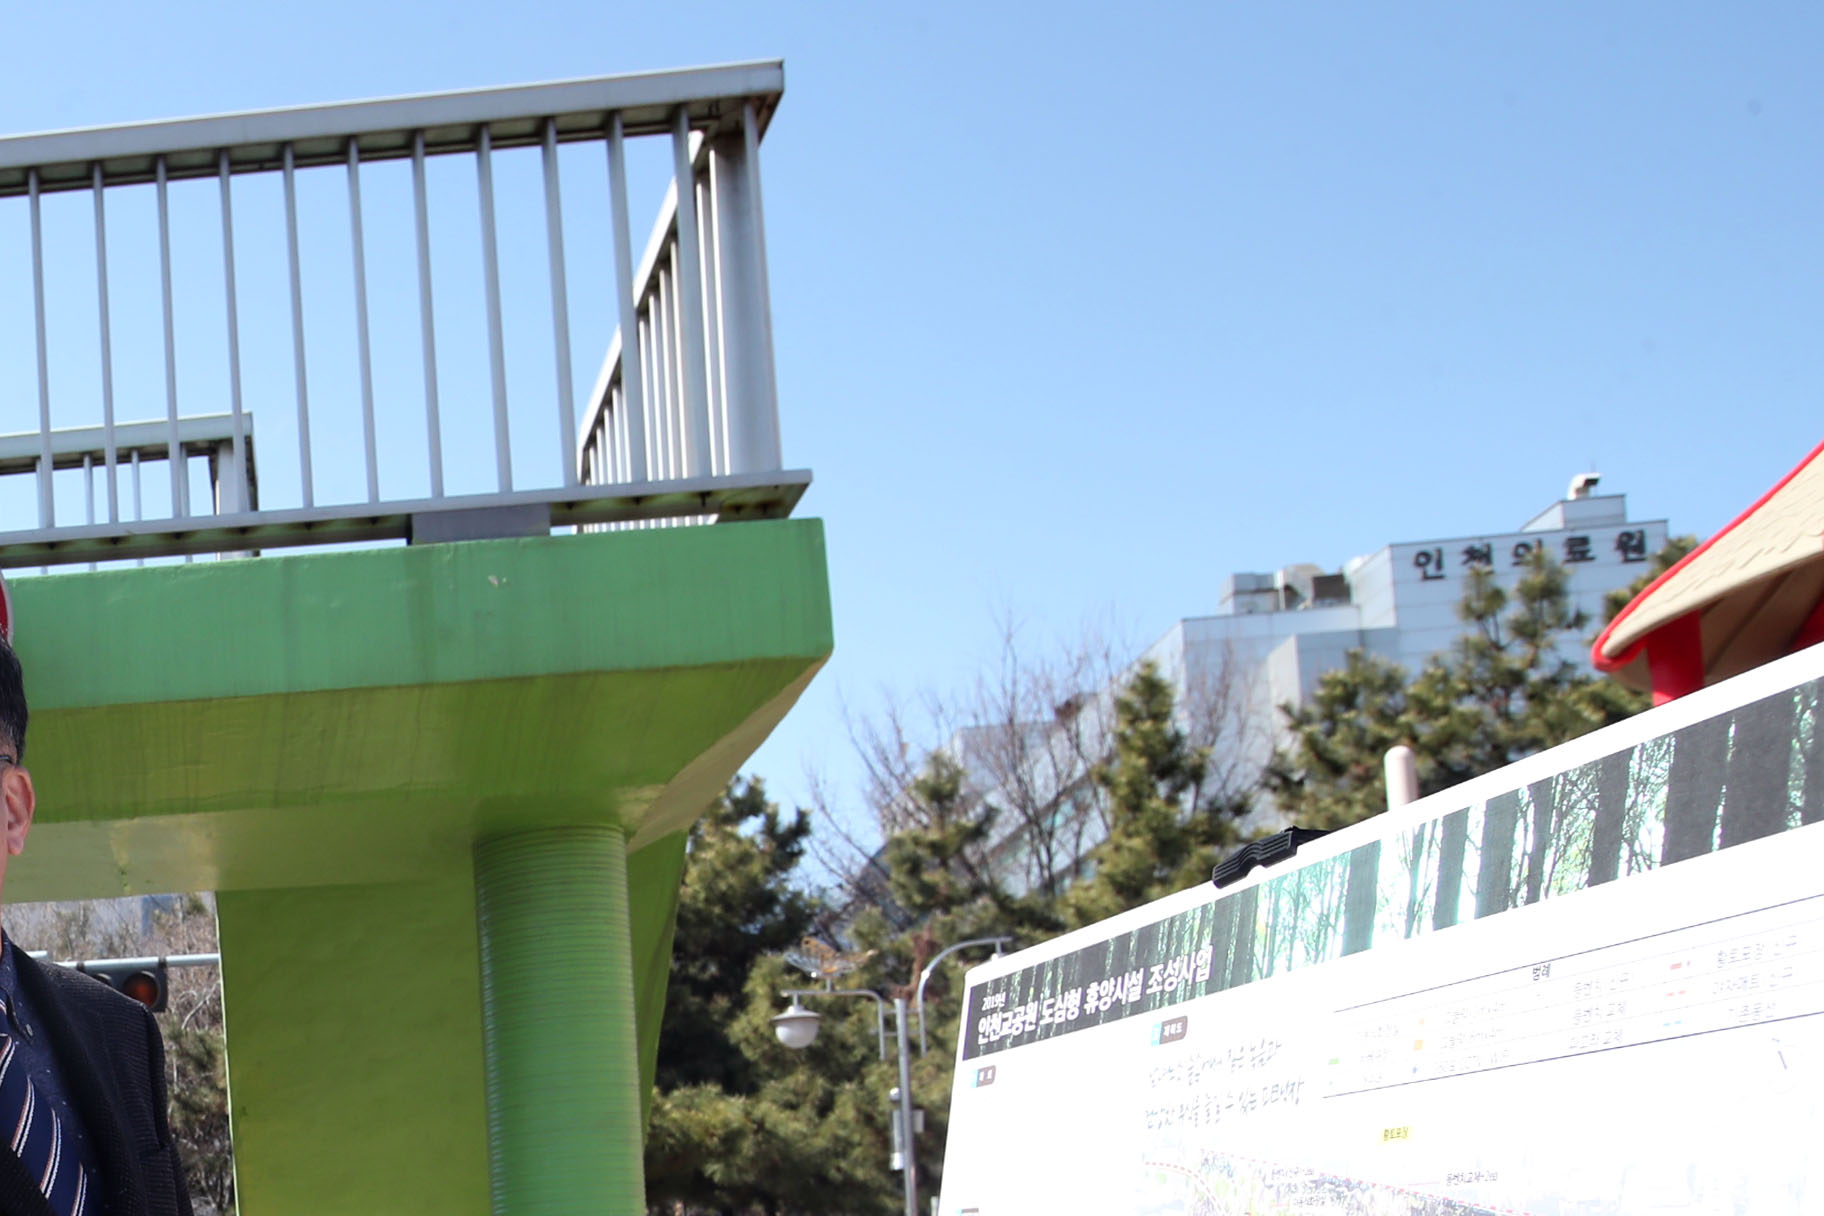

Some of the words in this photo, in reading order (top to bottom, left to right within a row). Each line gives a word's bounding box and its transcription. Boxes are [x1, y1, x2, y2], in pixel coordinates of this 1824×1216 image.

[977, 1001, 1039, 1045] 인천교공원
[1040, 987, 1083, 1025] 도심형
[1084, 968, 1145, 1015] 휴양시설
[1146, 946, 1214, 995] 조성사업
[981, 992, 1006, 1011] 2019년
